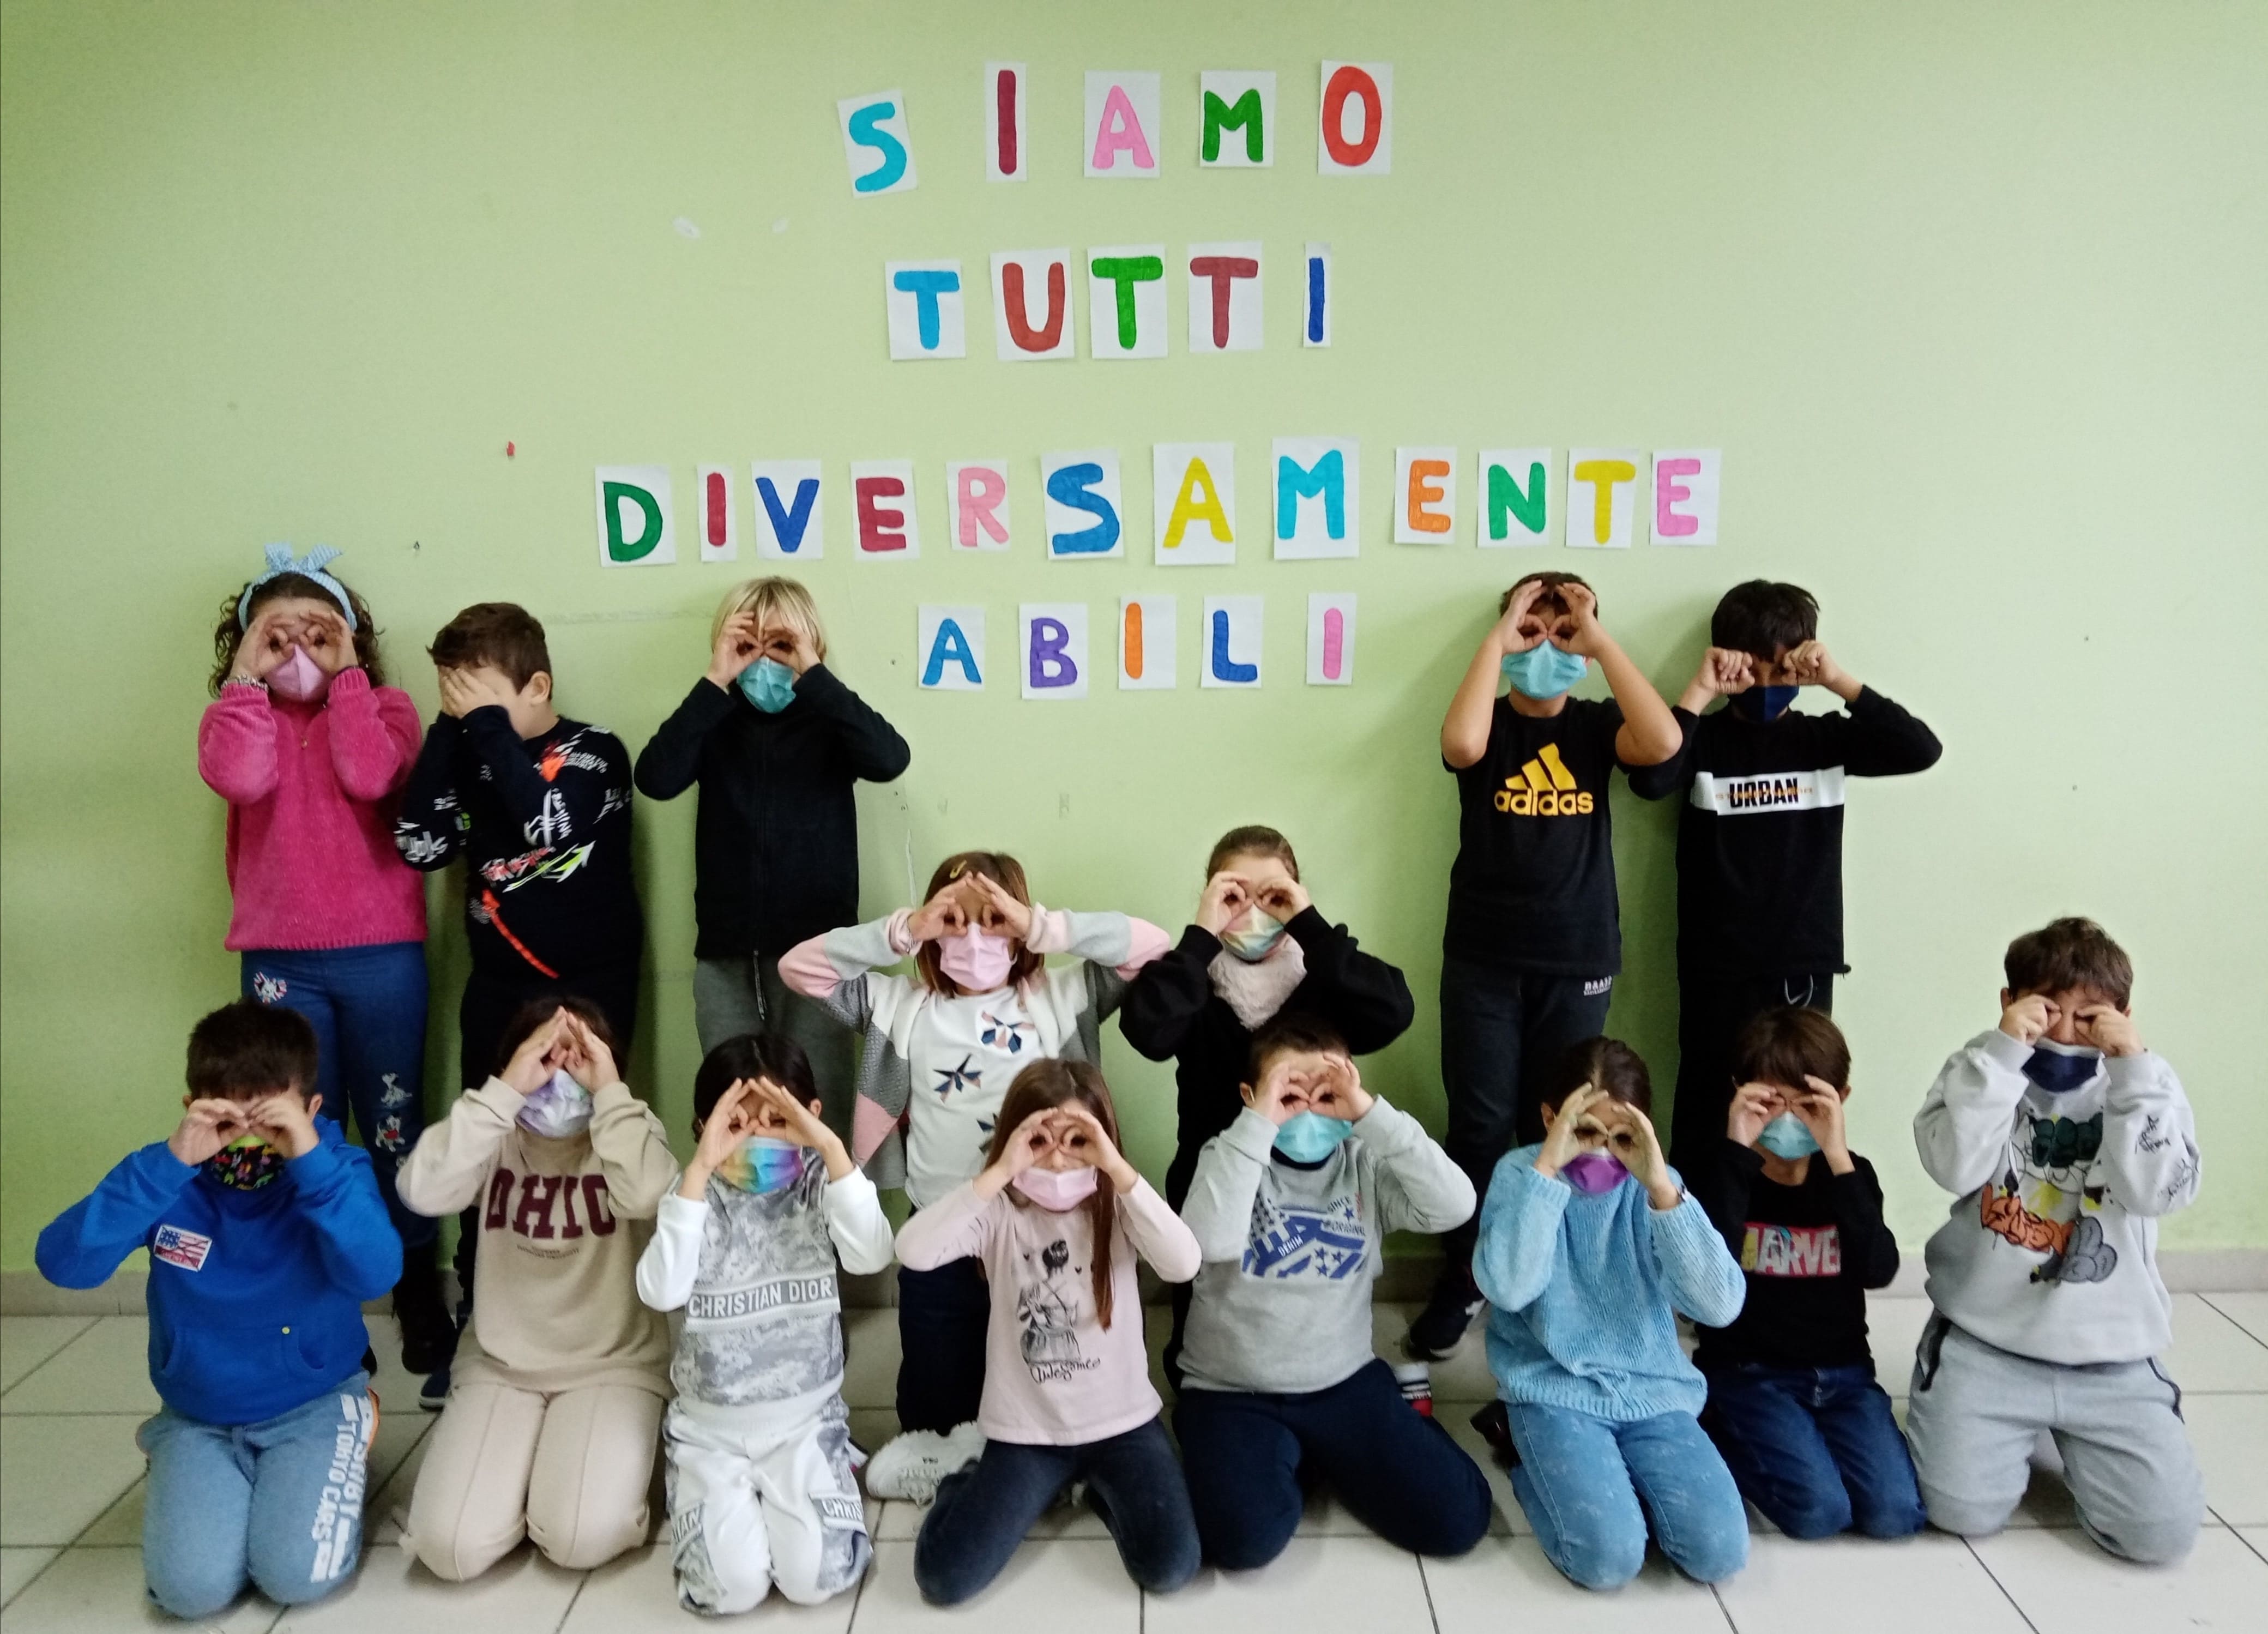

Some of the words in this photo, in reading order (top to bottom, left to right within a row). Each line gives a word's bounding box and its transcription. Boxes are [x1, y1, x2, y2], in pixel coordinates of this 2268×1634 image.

[848, 66, 1383, 192] SIAMO
[893, 256, 1325, 352] TUTTI
[603, 449, 1702, 562] DIVERSAMENTE
[921, 602, 1343, 688] ABILI
[1494, 789, 1594, 816] adidas
[1729, 777, 1798, 807] URBAN
[1277, 1234, 1304, 1258] DENIM
[687, 1283, 782, 1318] CHRISTIAN
[789, 1276, 834, 1303] DIOR
